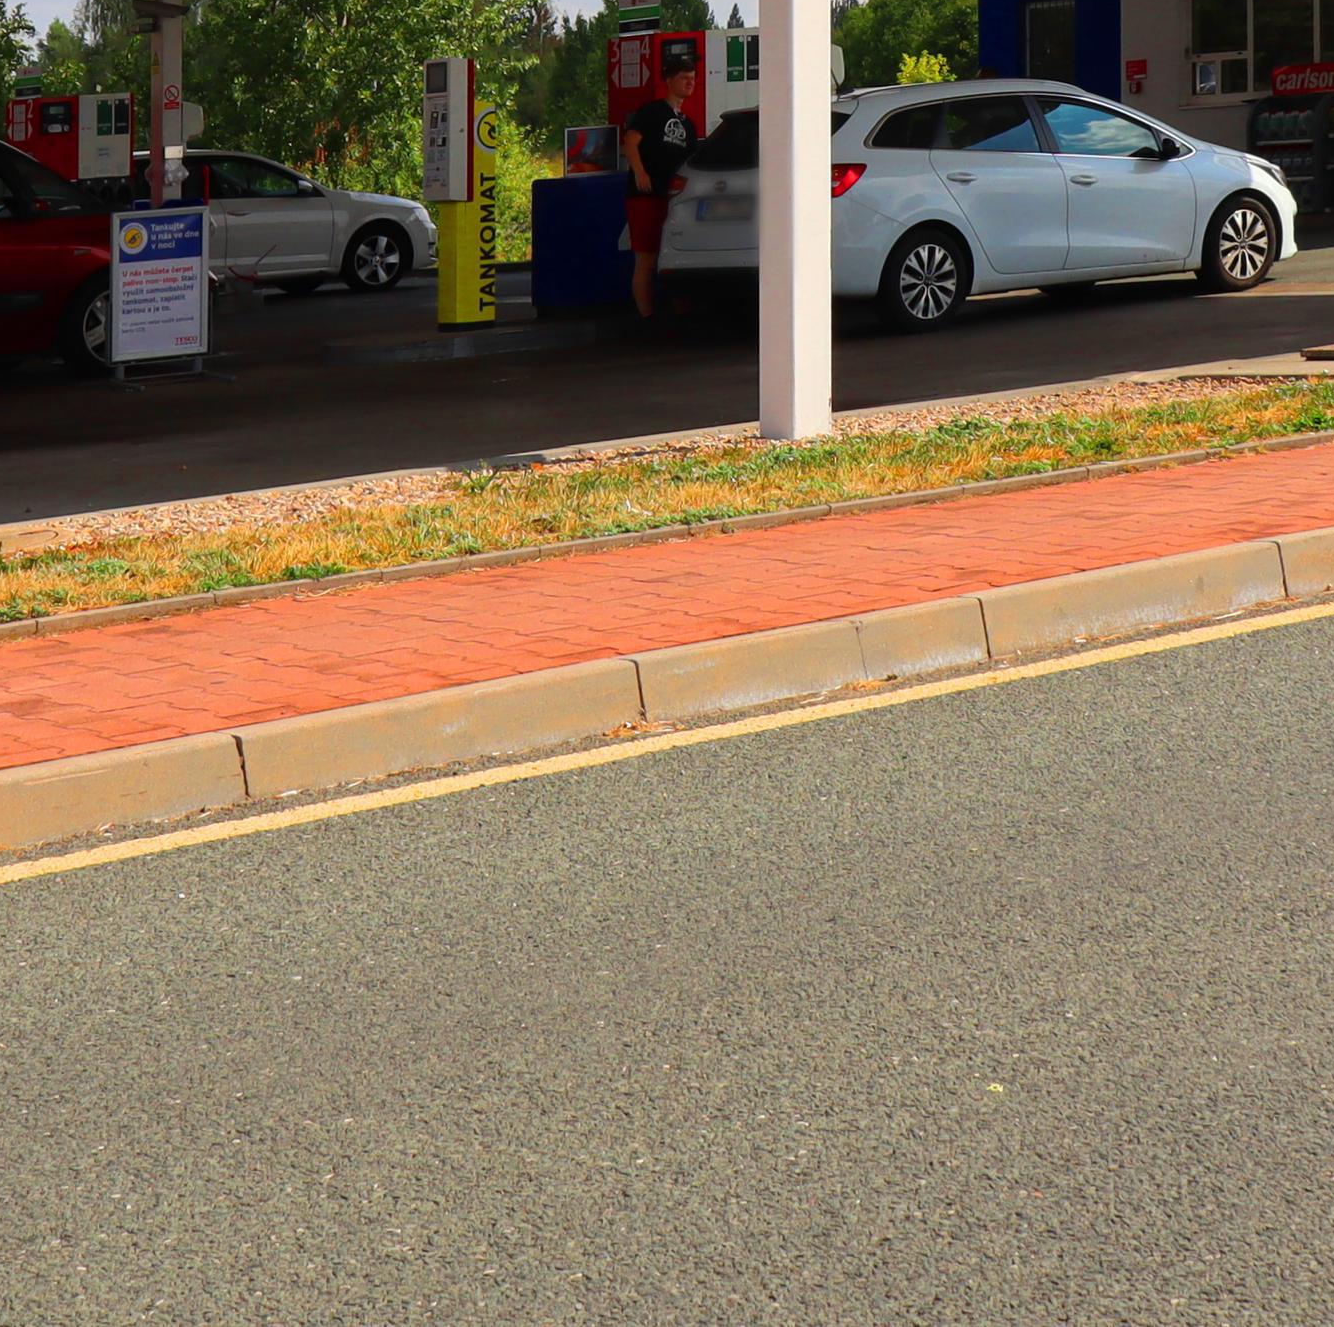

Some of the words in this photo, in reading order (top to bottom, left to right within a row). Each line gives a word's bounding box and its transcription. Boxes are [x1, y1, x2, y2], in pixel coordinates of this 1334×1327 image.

[610, 40, 620, 63] 3
[641, 36, 651, 59] 4
[27, 99, 34, 119] 2
[150, 222, 185, 232] Tankujte
[479, 172, 496, 312] TANKOMAT
